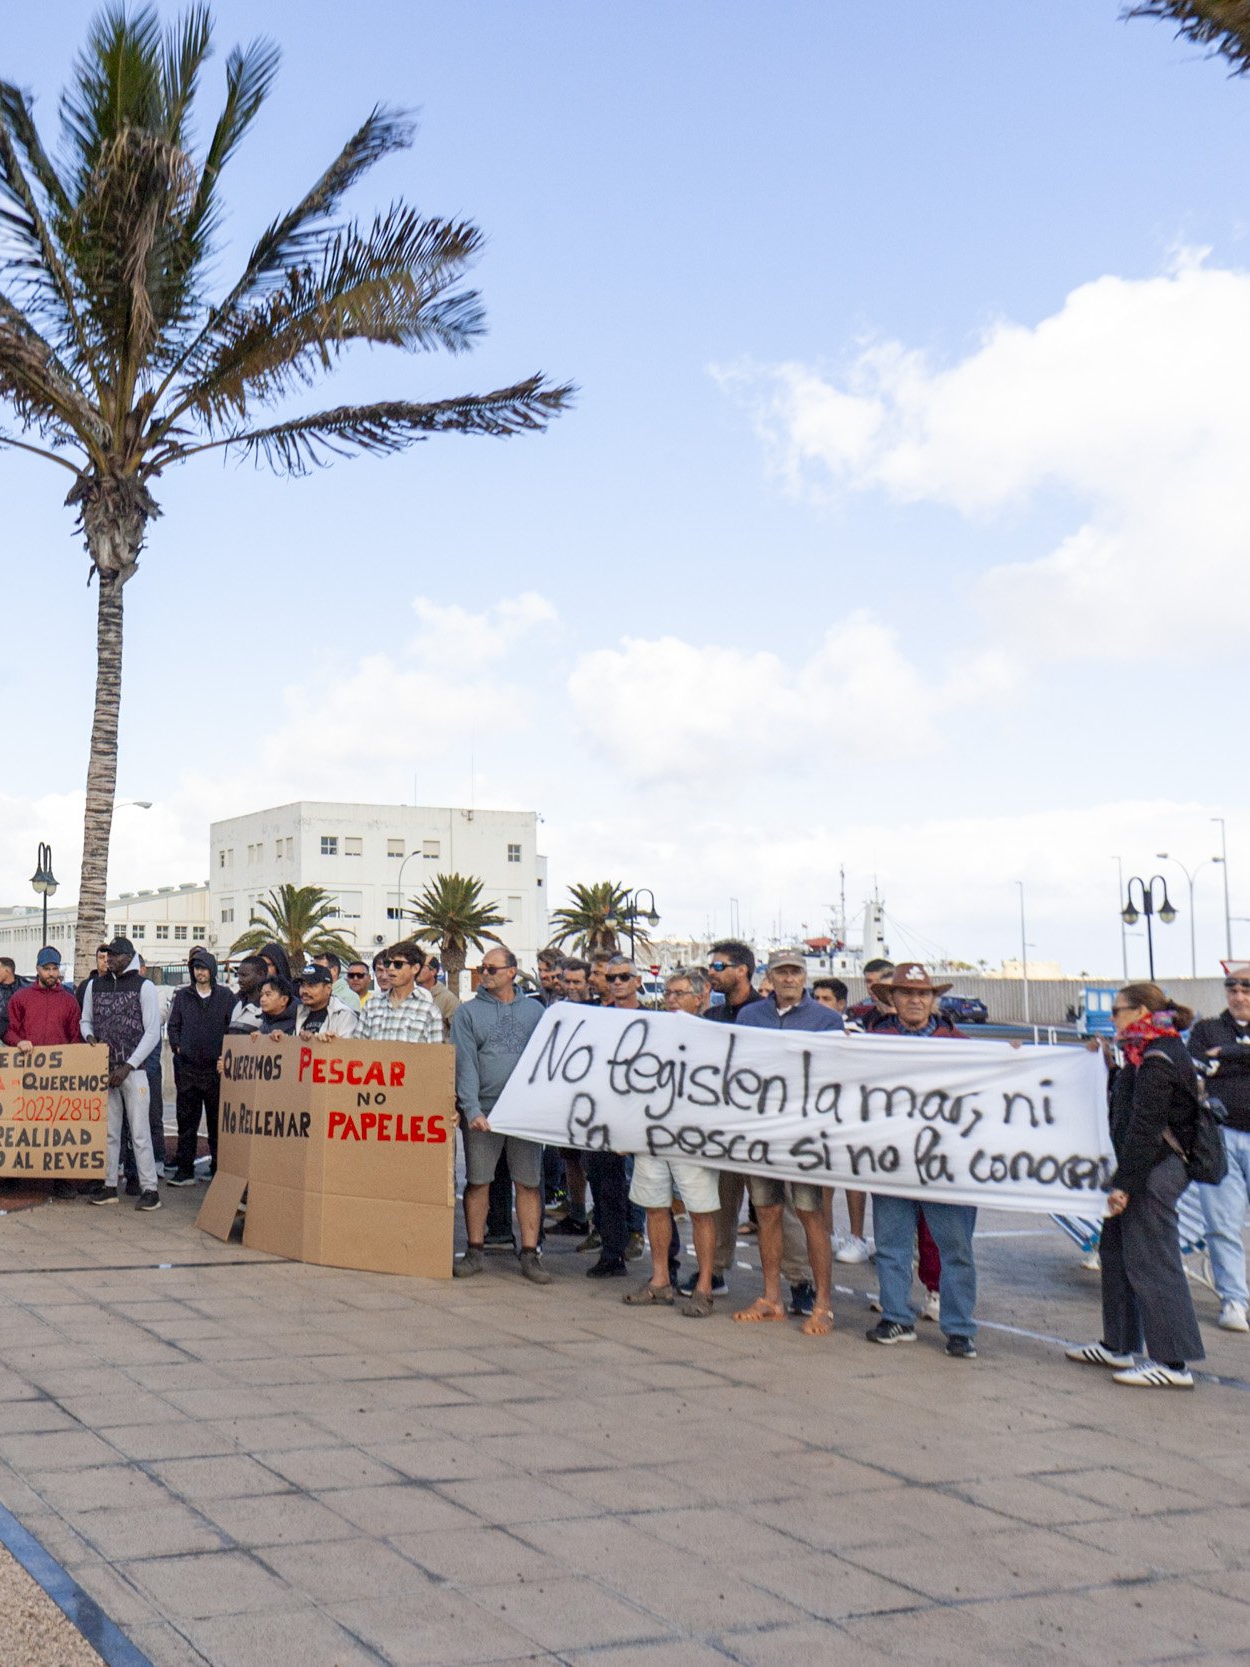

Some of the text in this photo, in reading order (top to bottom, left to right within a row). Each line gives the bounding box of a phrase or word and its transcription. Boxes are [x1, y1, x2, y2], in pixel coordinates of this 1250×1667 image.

[299, 1047, 406, 1086] PESCAR
[528, 1020, 594, 1084] No
[801, 1050, 842, 1123] la
[860, 1083, 984, 1138] mar,
[1002, 1079, 1054, 1128] ni
[11, 1095, 102, 1125] 2023/2843
[357, 1092, 386, 1107] NO
[327, 1111, 447, 1143] PAPELES
[12, 1151, 34, 1169] AL
[43, 1151, 104, 1170] REVES
[646, 1125, 773, 1165] pesca
[789, 1131, 831, 1171] si
[846, 1144, 900, 1176] no
[914, 1125, 954, 1185] la
